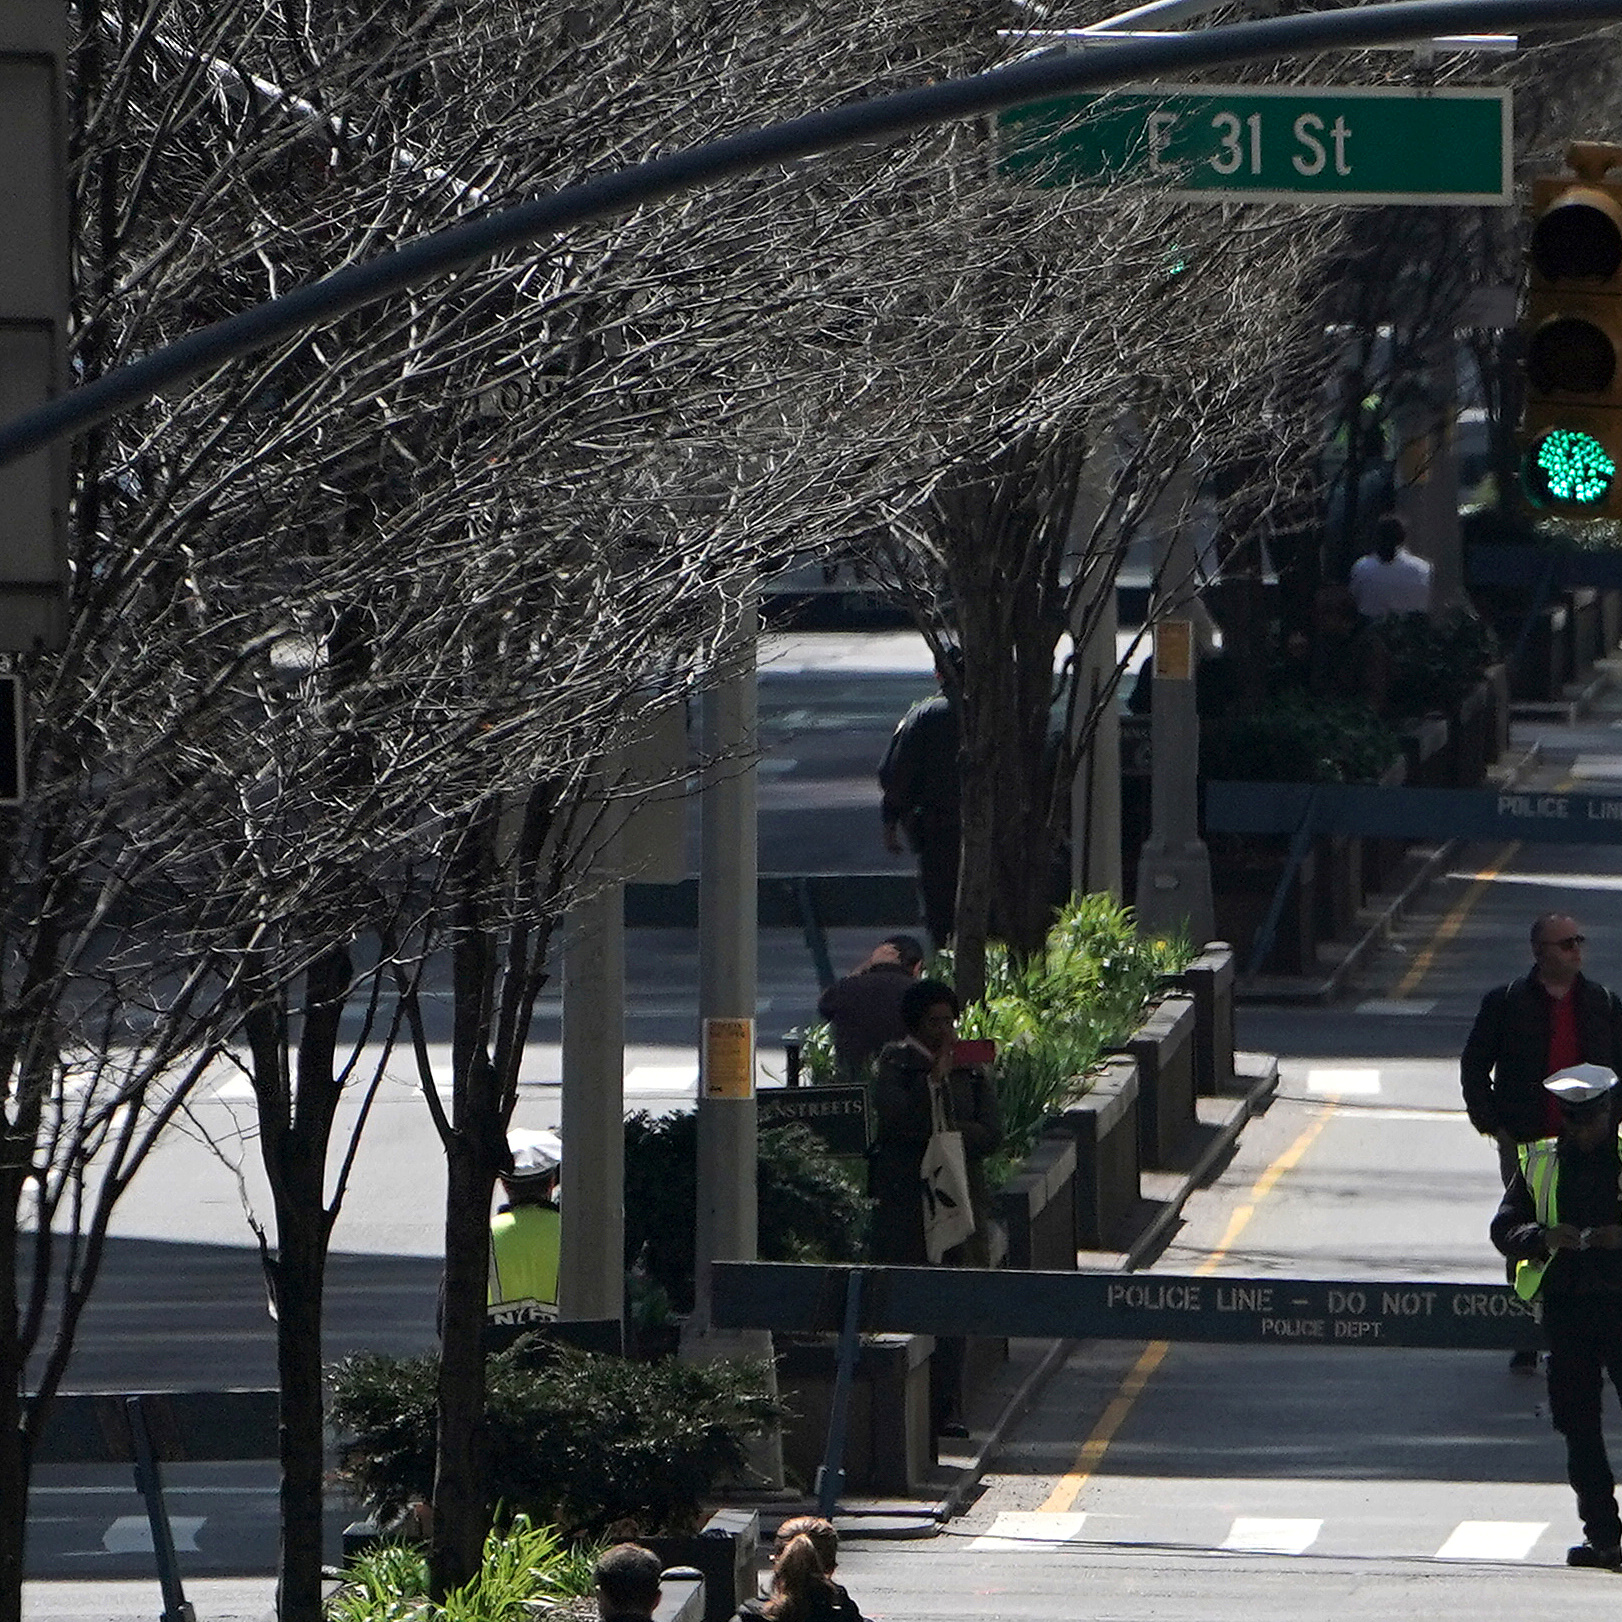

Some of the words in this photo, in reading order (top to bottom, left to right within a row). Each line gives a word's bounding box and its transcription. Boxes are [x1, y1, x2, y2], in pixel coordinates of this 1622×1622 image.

[1149, 111, 1185, 175] E
[1211, 110, 1262, 175] 31
[1291, 112, 1353, 177] St
[1107, 1284, 1201, 1312] POLICE
[1216, 1287, 1274, 1313] LINE
[1328, 1291, 1367, 1316] DO
[1381, 1291, 1438, 1318] NOT
[1262, 1319, 1325, 1338] POLICE
